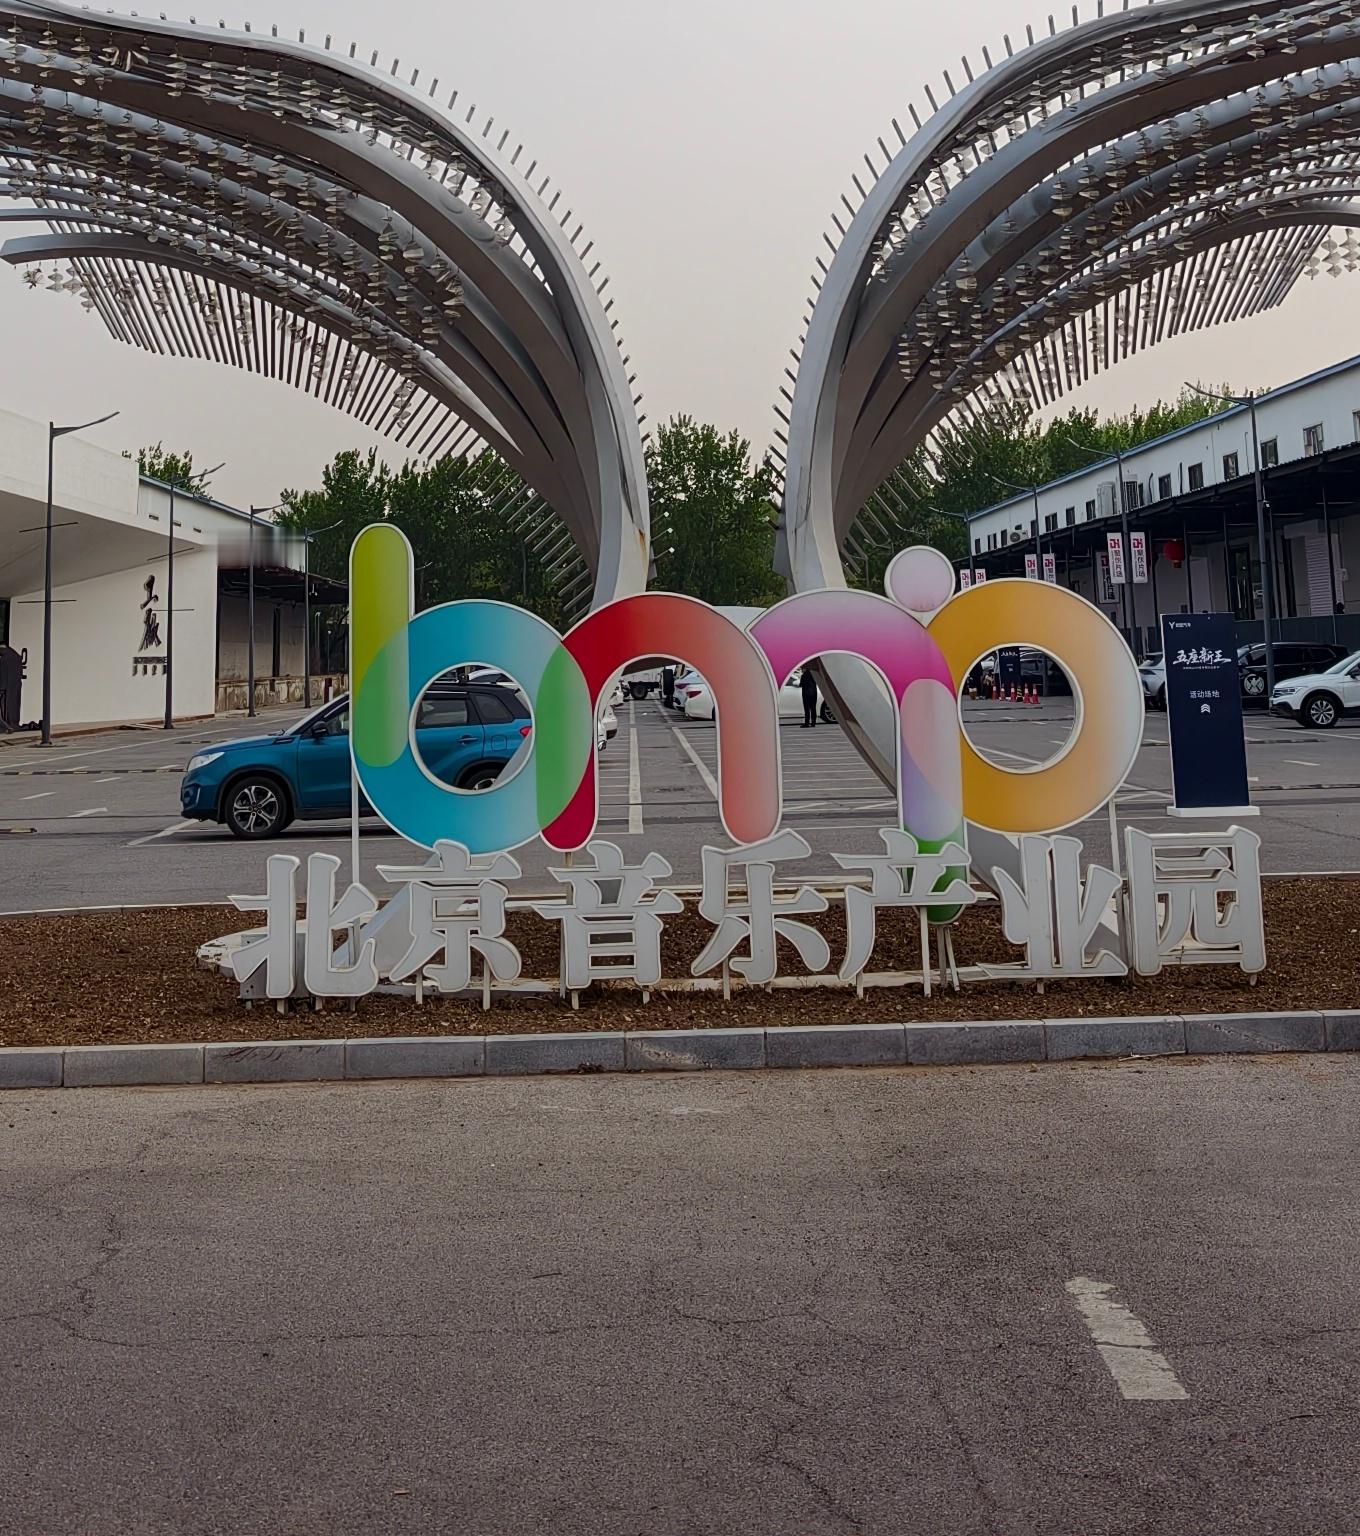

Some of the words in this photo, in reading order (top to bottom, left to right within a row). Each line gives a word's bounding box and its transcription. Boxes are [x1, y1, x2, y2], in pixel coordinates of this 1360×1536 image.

[1172, 646, 1232, 665] 五座新王
[226, 824, 1267, 999] 北京音乐产业园
